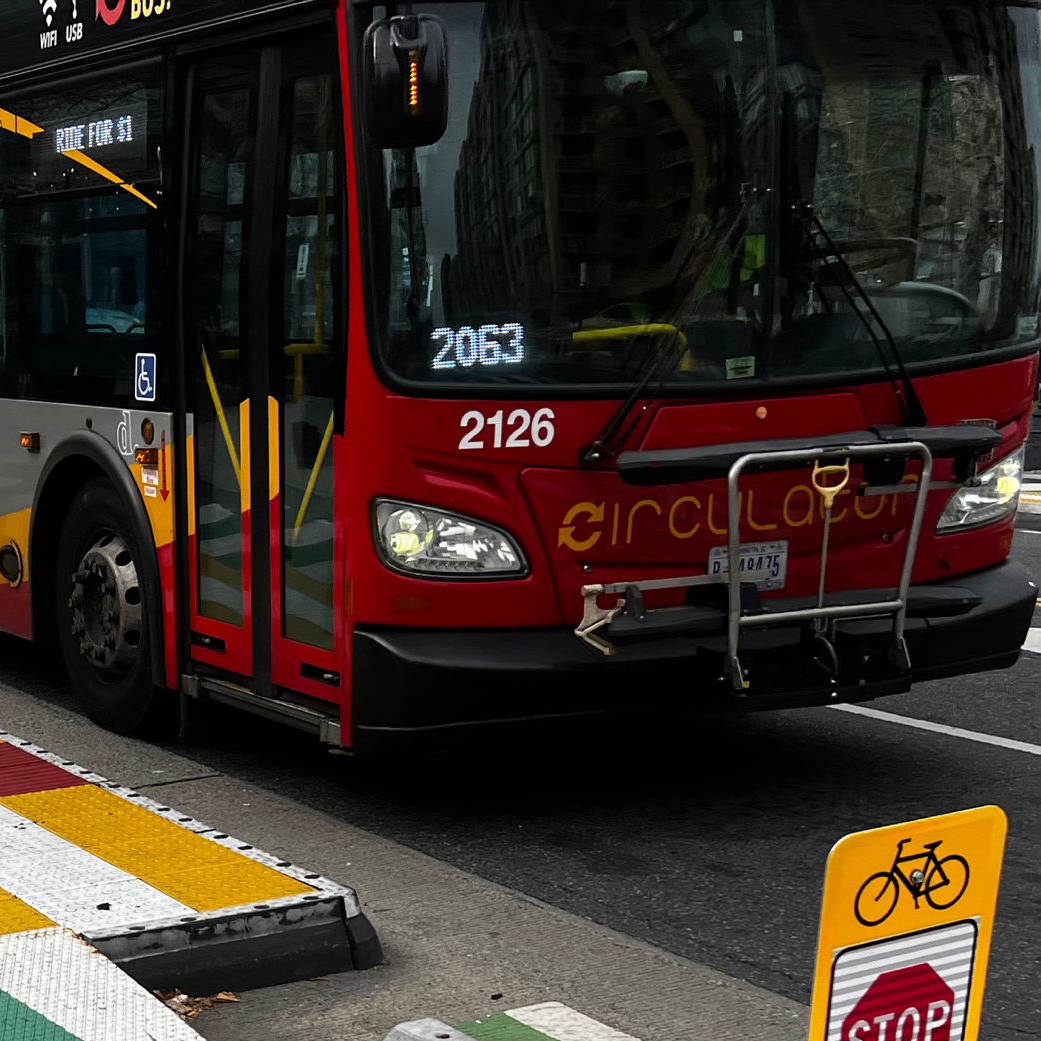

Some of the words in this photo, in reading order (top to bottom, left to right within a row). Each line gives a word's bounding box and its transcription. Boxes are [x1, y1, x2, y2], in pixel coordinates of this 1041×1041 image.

[39, 30, 58, 50] WIFI
[65, 22, 83, 43] USB
[56, 125, 85, 153] RIDE
[88, 119, 113, 147] FOR
[116, 115, 132, 142] $1
[430, 322, 524, 369] 2063
[458, 407, 555, 450] 2126
